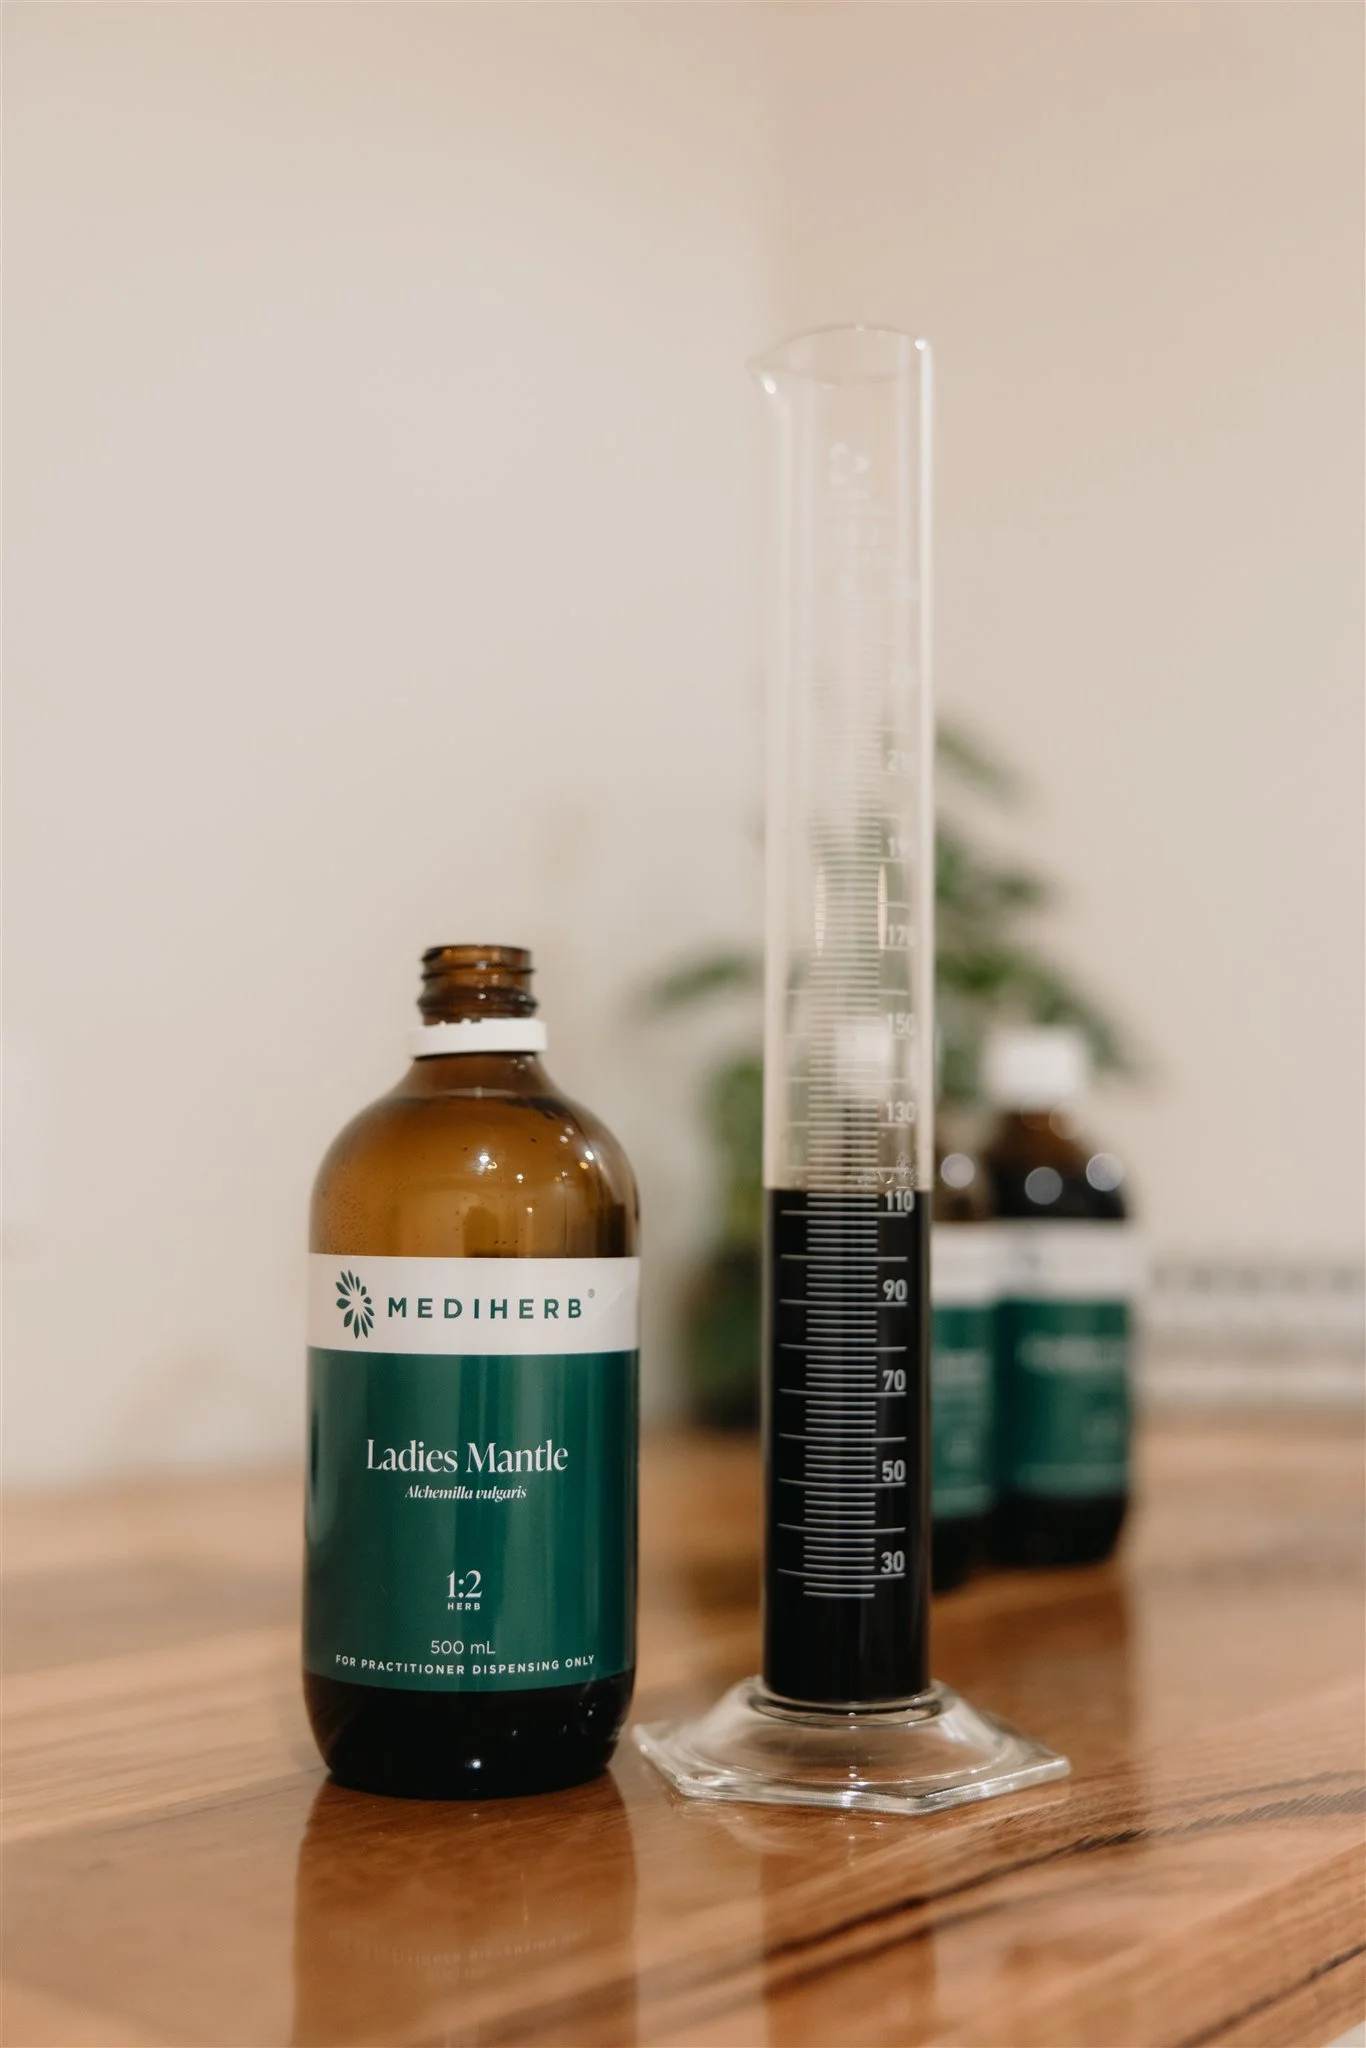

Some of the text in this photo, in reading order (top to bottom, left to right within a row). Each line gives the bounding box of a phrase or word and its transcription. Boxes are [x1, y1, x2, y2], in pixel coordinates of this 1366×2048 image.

[886, 1011, 915, 1036] 150
[886, 1101, 915, 1123] 130
[885, 1190, 915, 1213] 110
[883, 1279, 908, 1301] 90
[388, 1296, 582, 1319] MEDIHERB
[882, 1369, 907, 1391] 70
[366, 1439, 568, 1473] Ladies Mantle
[881, 1460, 906, 1482] 50
[405, 1485, 527, 1502] Alchemilla vulgaris
[880, 1551, 906, 1573] 30
[446, 1569, 483, 1599] 1:2
[447, 1602, 481, 1611] HERB
[430, 1640, 496, 1654] 500 mL
[335, 1654, 595, 1675] FOR PRACTITIONER DISPENSING ONLY
